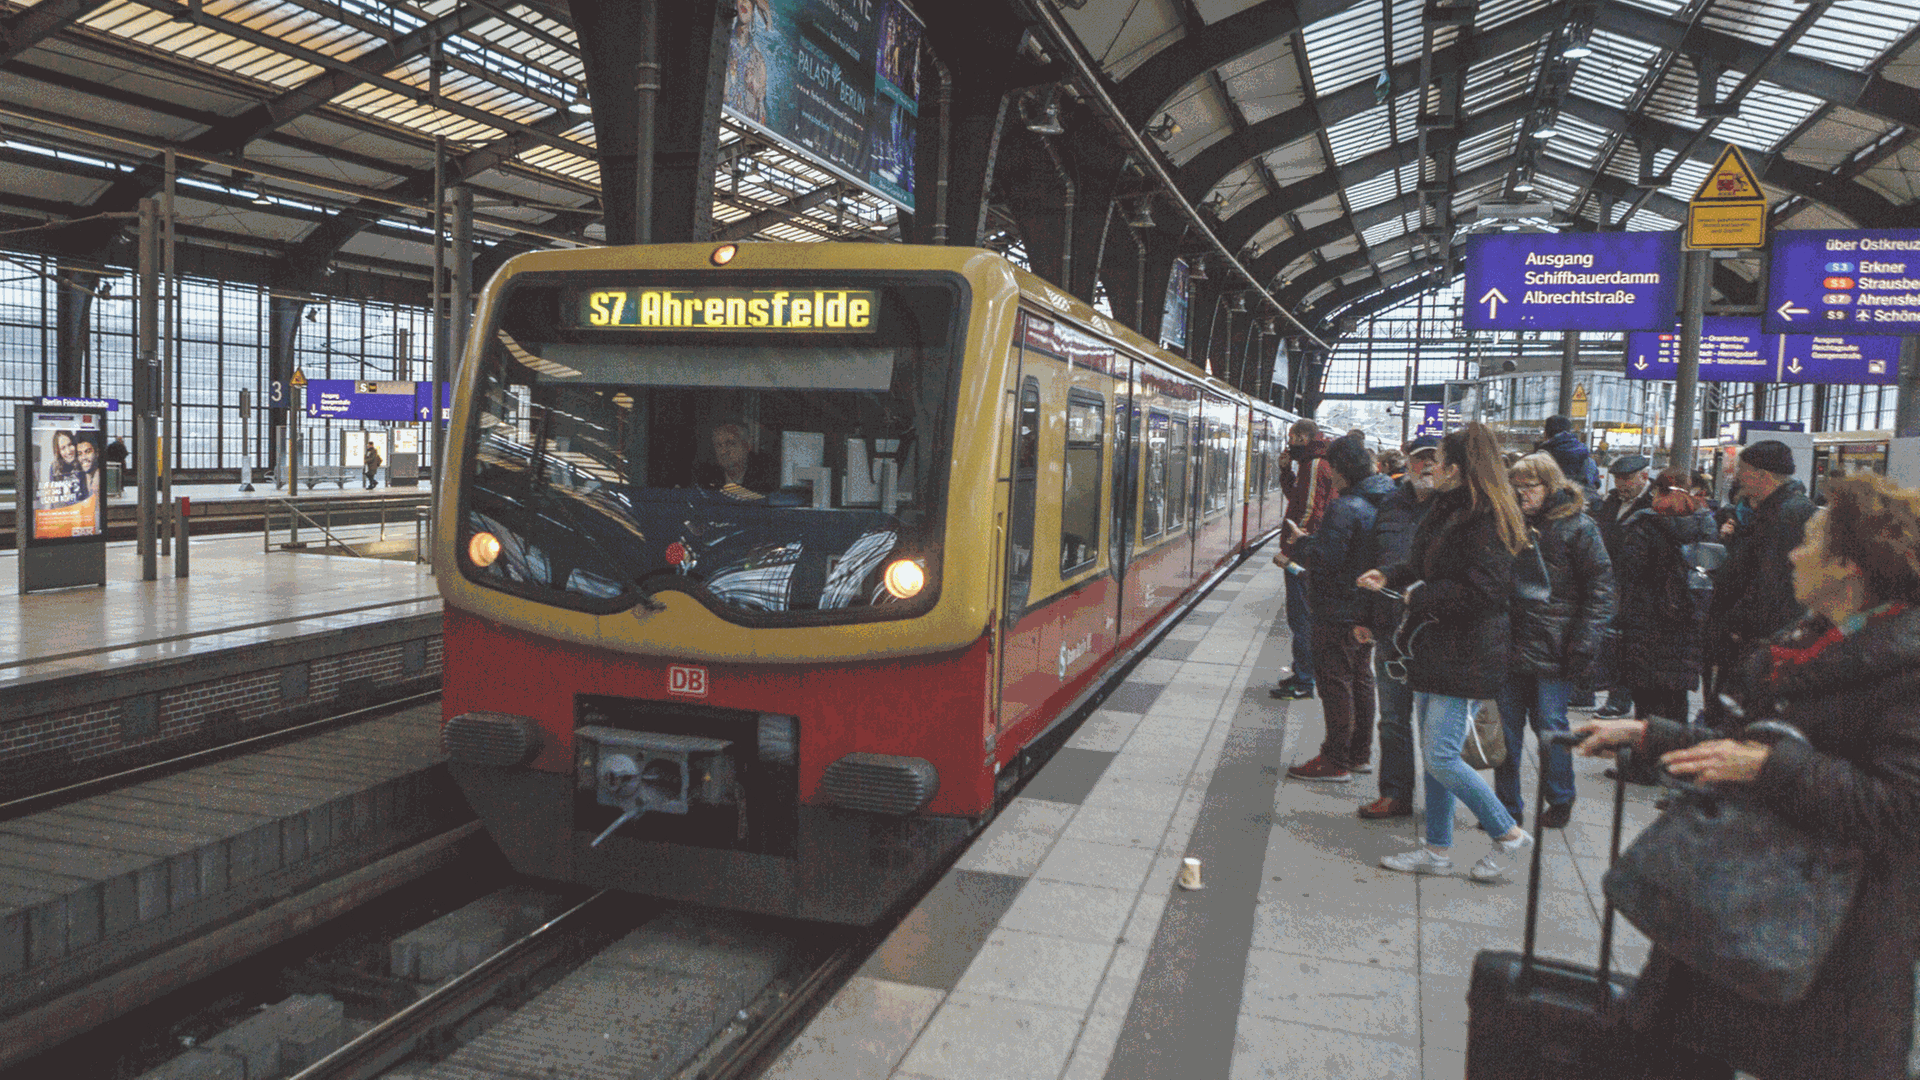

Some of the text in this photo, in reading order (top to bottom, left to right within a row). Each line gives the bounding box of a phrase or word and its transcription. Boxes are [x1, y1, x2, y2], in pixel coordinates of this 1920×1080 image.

[798, 49, 831, 90] PALAST
[840, 80, 866, 116] BERLIN
[1826, 238, 1920, 251] über Ostkreuz
[1525, 252, 1594, 268] Ausgang
[1859, 260, 1906, 273] Erkner
[1524, 270, 1660, 285] Schiffbauerdamm
[1522, 290, 1636, 304] Albrechtstraße
[590, 290, 871, 328] S7 Ahrensfelde
[271, 381, 282, 401] 3
[42, 397, 62, 406] Berlin
[671, 667, 704, 692] DB
